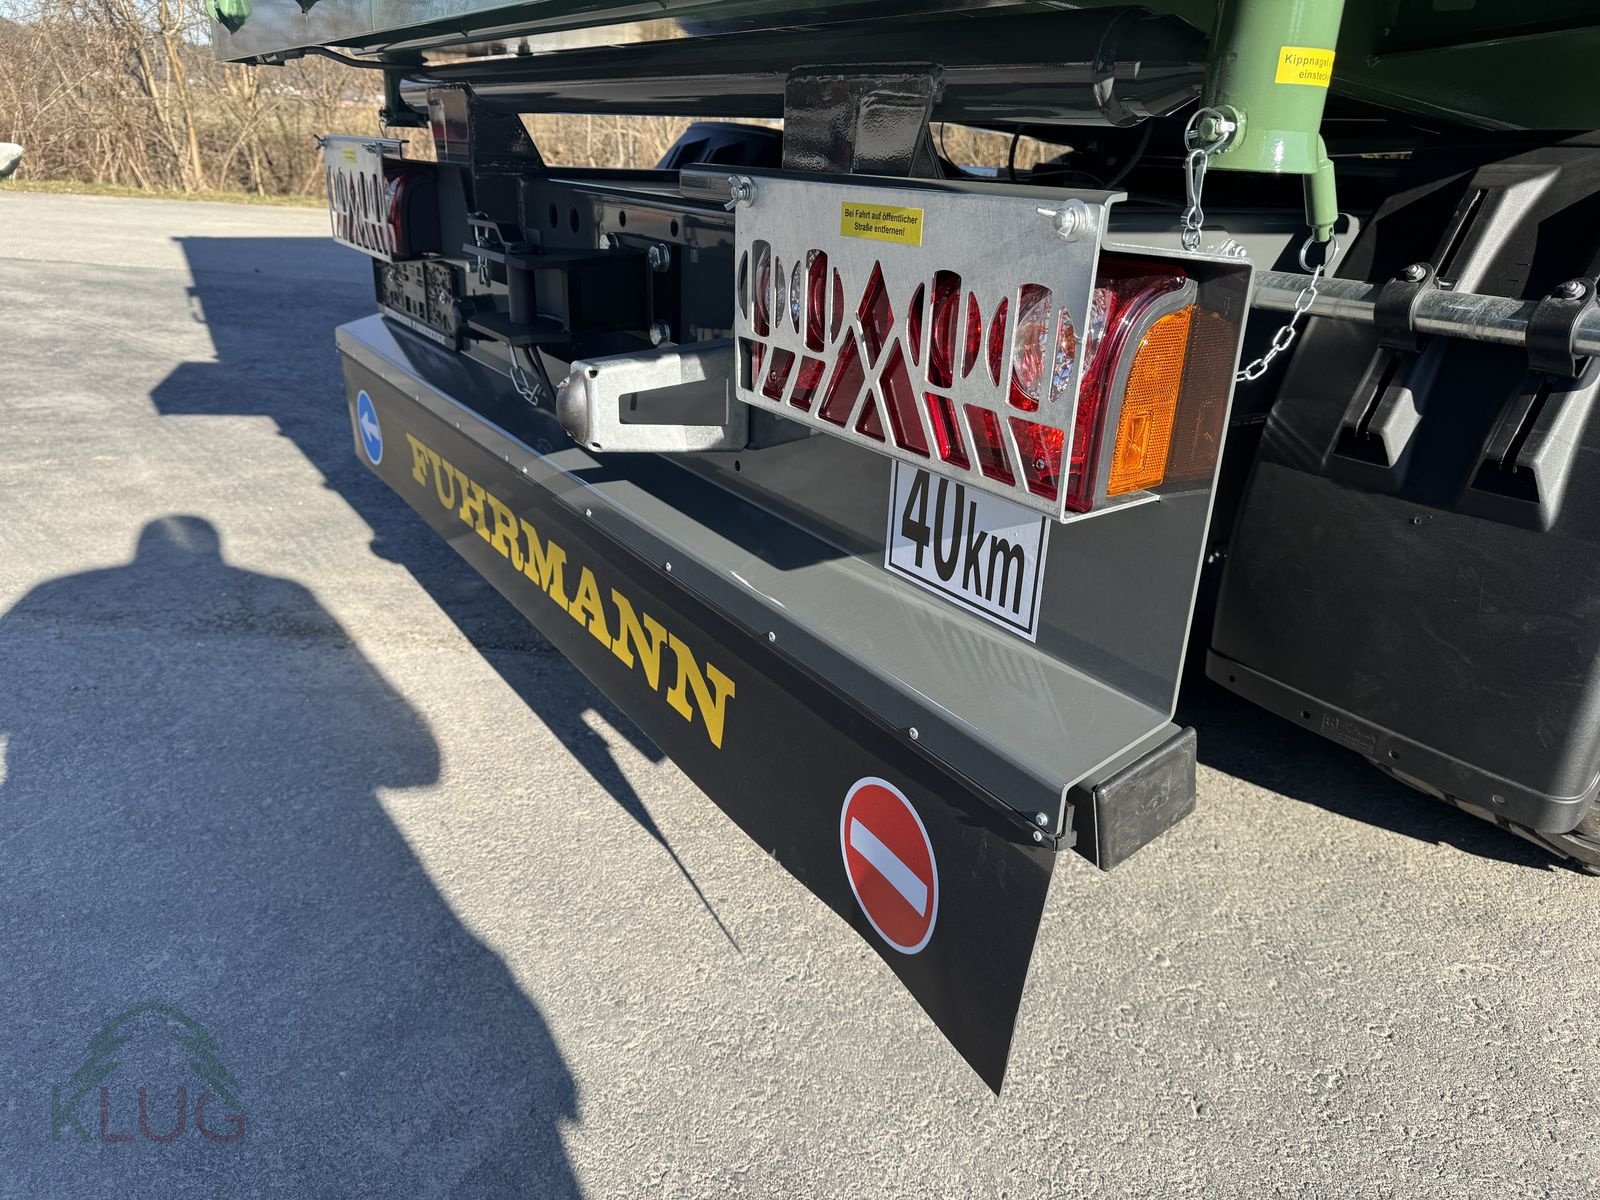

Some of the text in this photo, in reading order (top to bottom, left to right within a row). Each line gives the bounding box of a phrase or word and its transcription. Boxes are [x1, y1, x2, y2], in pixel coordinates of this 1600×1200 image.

[844, 208, 918, 225] Bei Fahrt auf öffentlicher
[854, 221, 906, 236] Straße entfernen!
[406, 432, 736, 750] FUHRMANN
